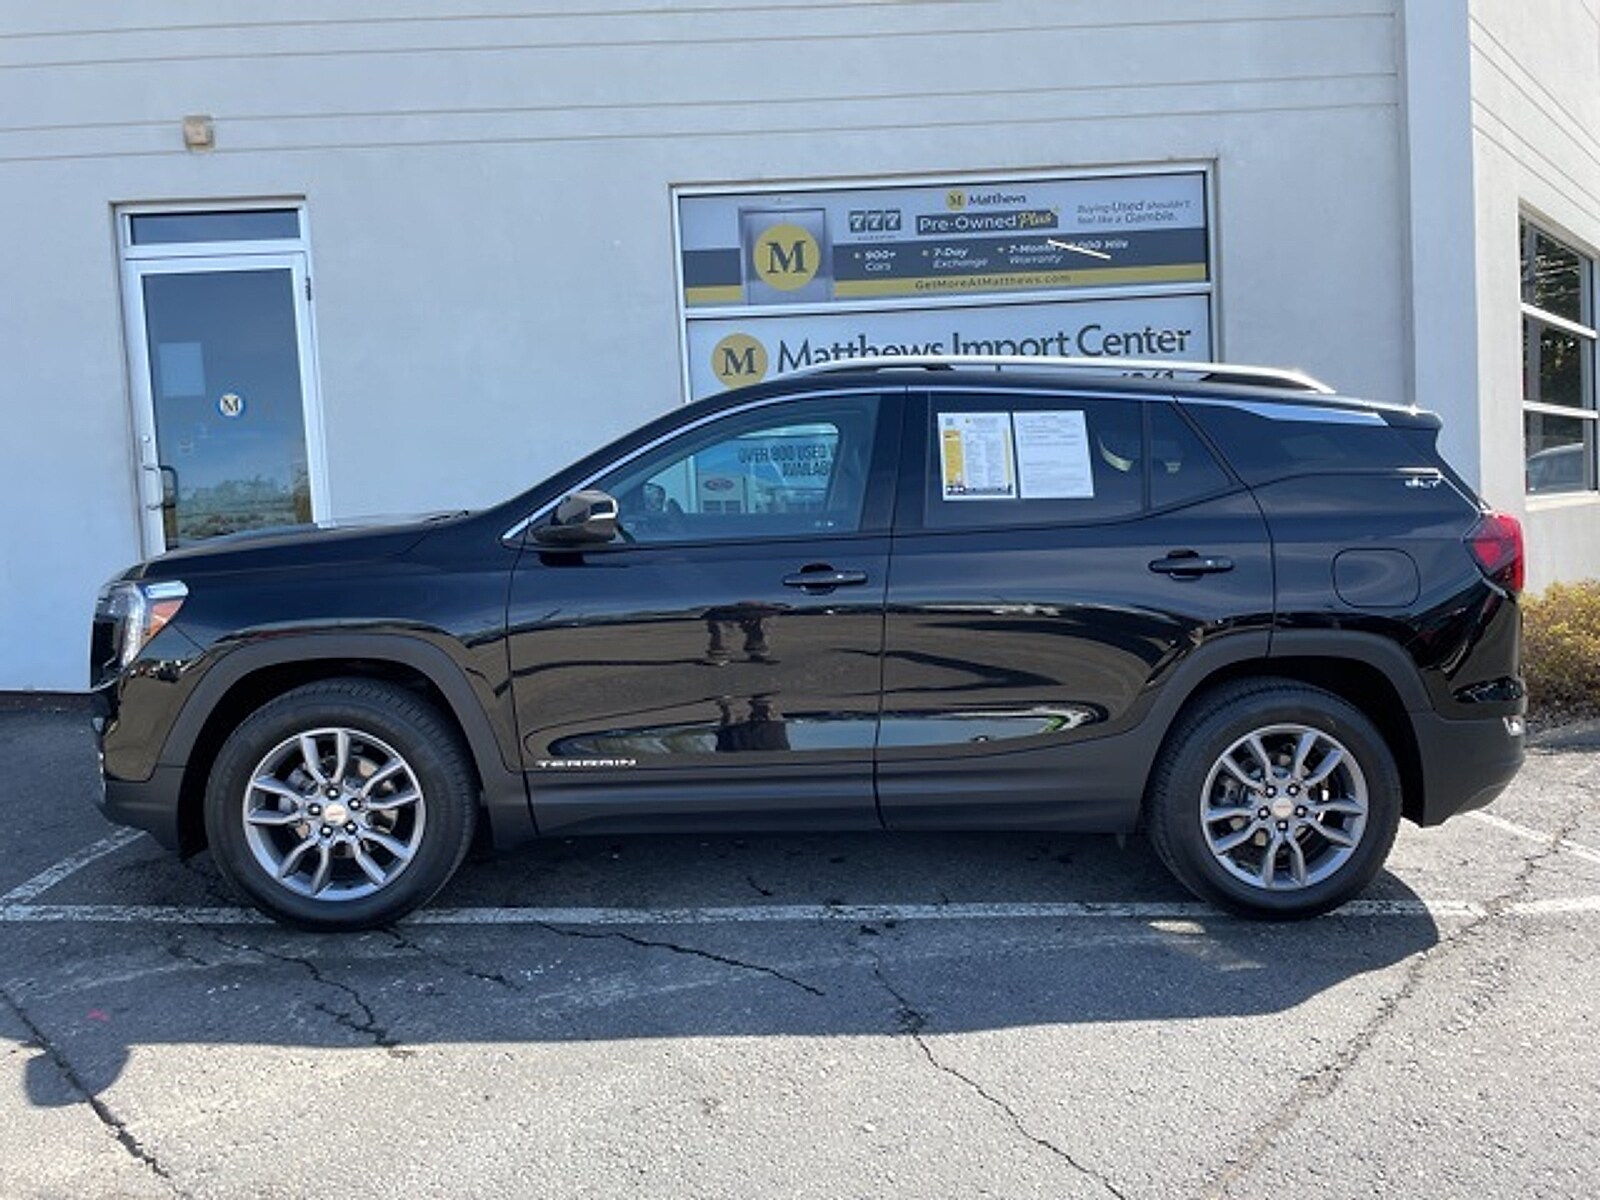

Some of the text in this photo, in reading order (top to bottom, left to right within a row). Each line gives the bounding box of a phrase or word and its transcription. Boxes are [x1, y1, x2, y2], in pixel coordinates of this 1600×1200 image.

[967, 193, 1027, 206] Matthews
[1112, 201, 1144, 213] Used
[919, 215, 1016, 232] Pre-Owned
[766, 240, 808, 274] M
[932, 257, 989, 270] Exchange
[1009, 254, 1064, 266] Warranty
[864, 262, 892, 272] Cars
[914, 274, 1071, 290] GetMoreAtMatthews.com
[777, 324, 1192, 373] Matthews Import Center
[720, 347, 758, 376] M
[535, 759, 637, 767] TERRAIN
